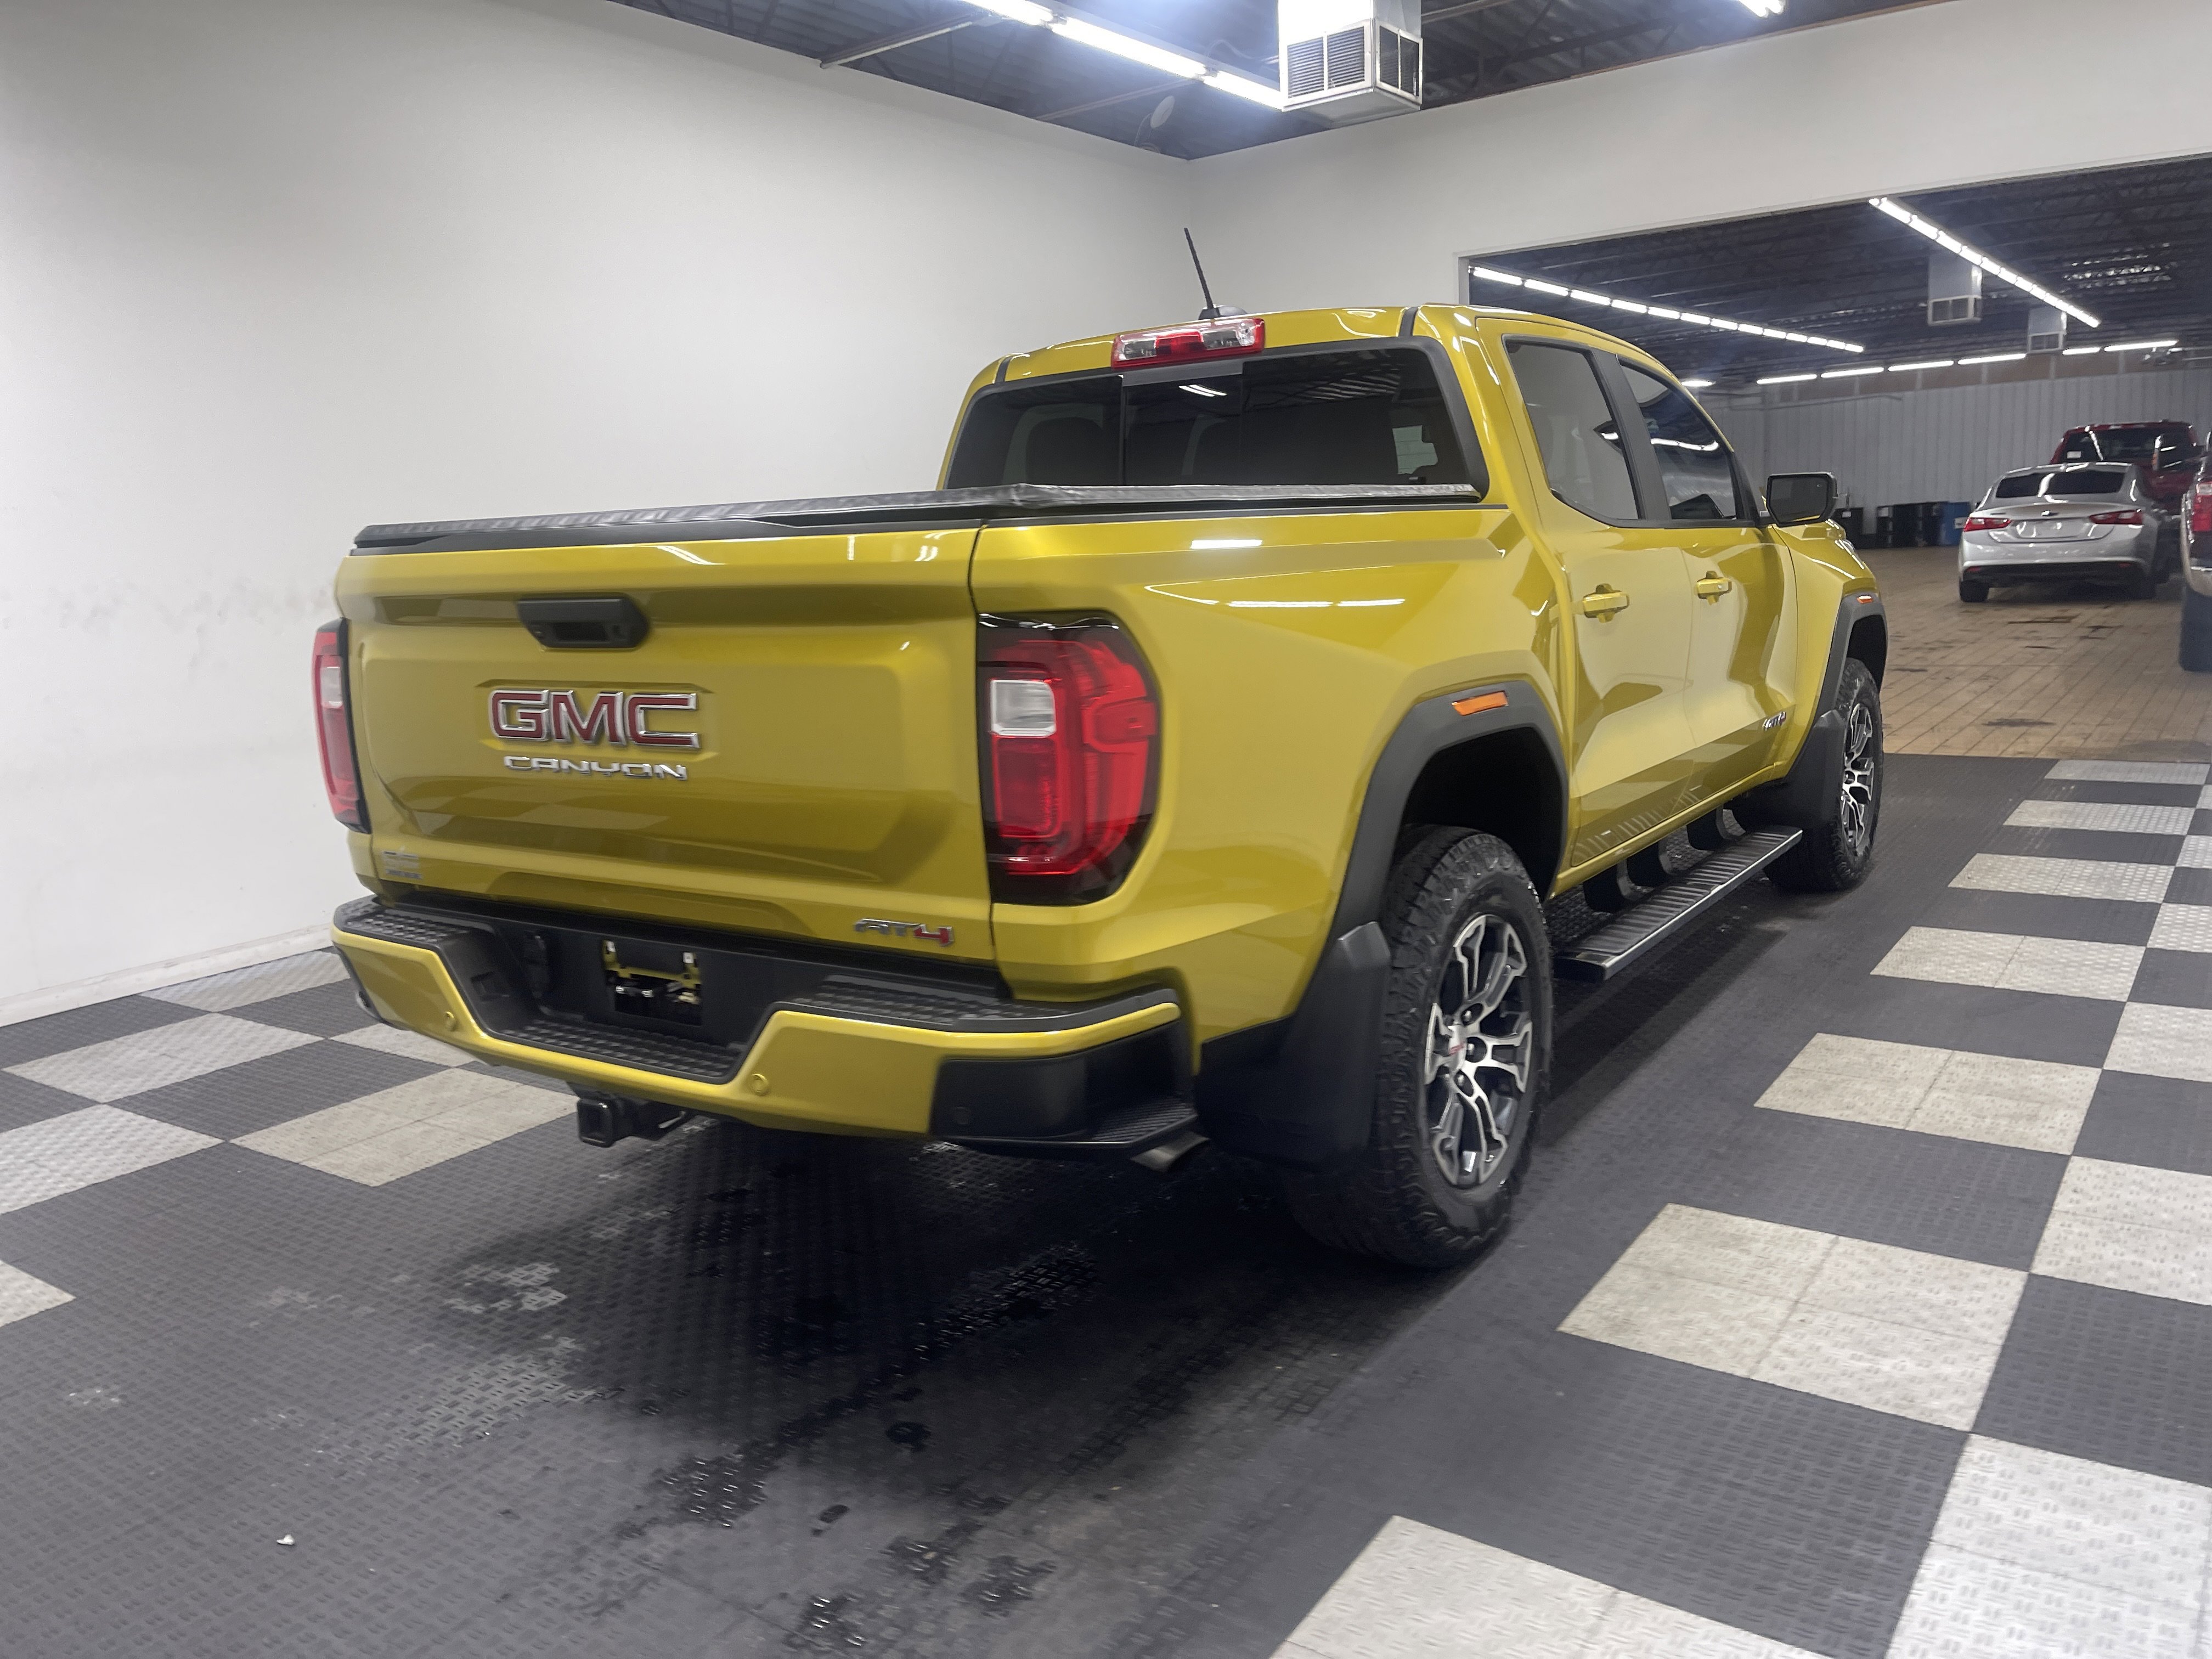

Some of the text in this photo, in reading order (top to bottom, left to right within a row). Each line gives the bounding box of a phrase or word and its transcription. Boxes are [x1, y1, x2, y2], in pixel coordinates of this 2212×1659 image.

[490, 690, 700, 749] GMC
[504, 755, 687, 781] CANYON
[855, 918, 955, 947] AT4
